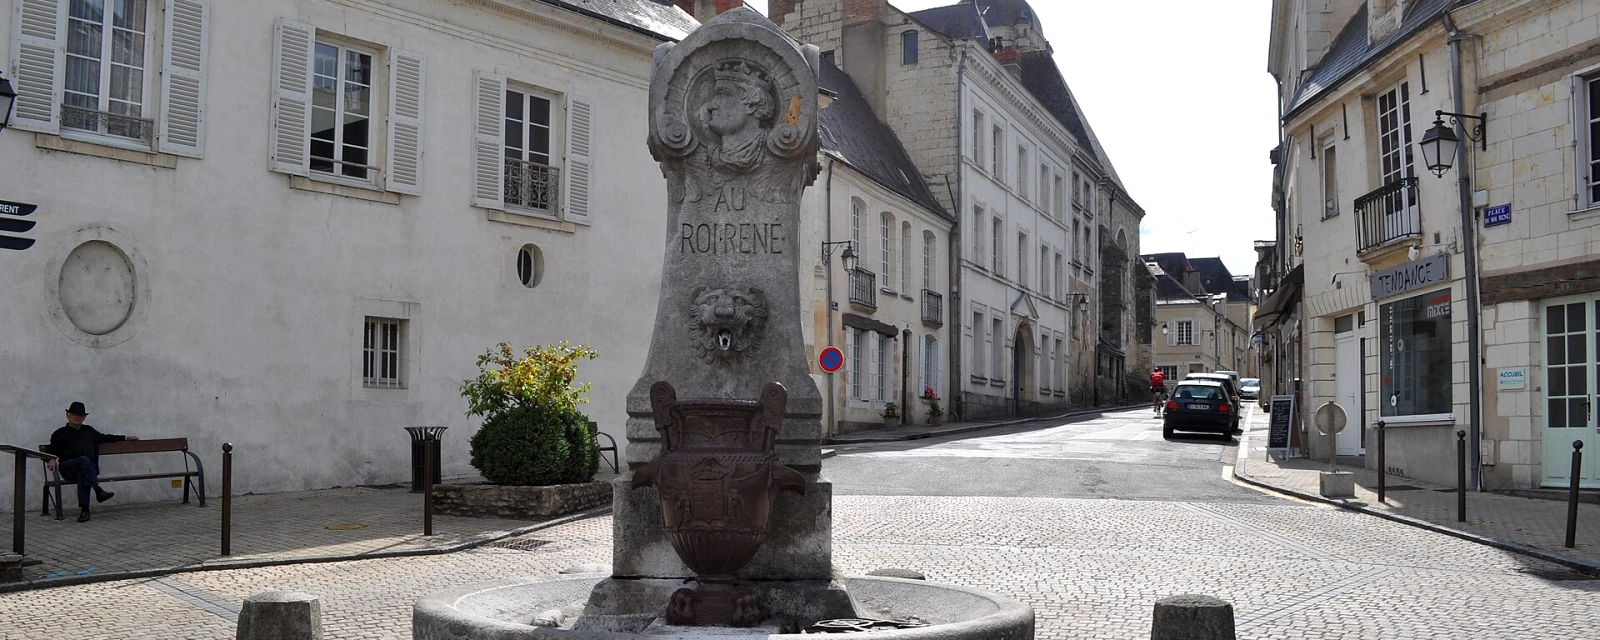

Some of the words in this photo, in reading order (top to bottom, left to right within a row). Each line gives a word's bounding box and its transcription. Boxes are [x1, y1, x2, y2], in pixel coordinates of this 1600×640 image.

[713, 187, 746, 212] AU
[1488, 208, 1505, 216] PLACE
[1378, 262, 1433, 293] TENDANCE
